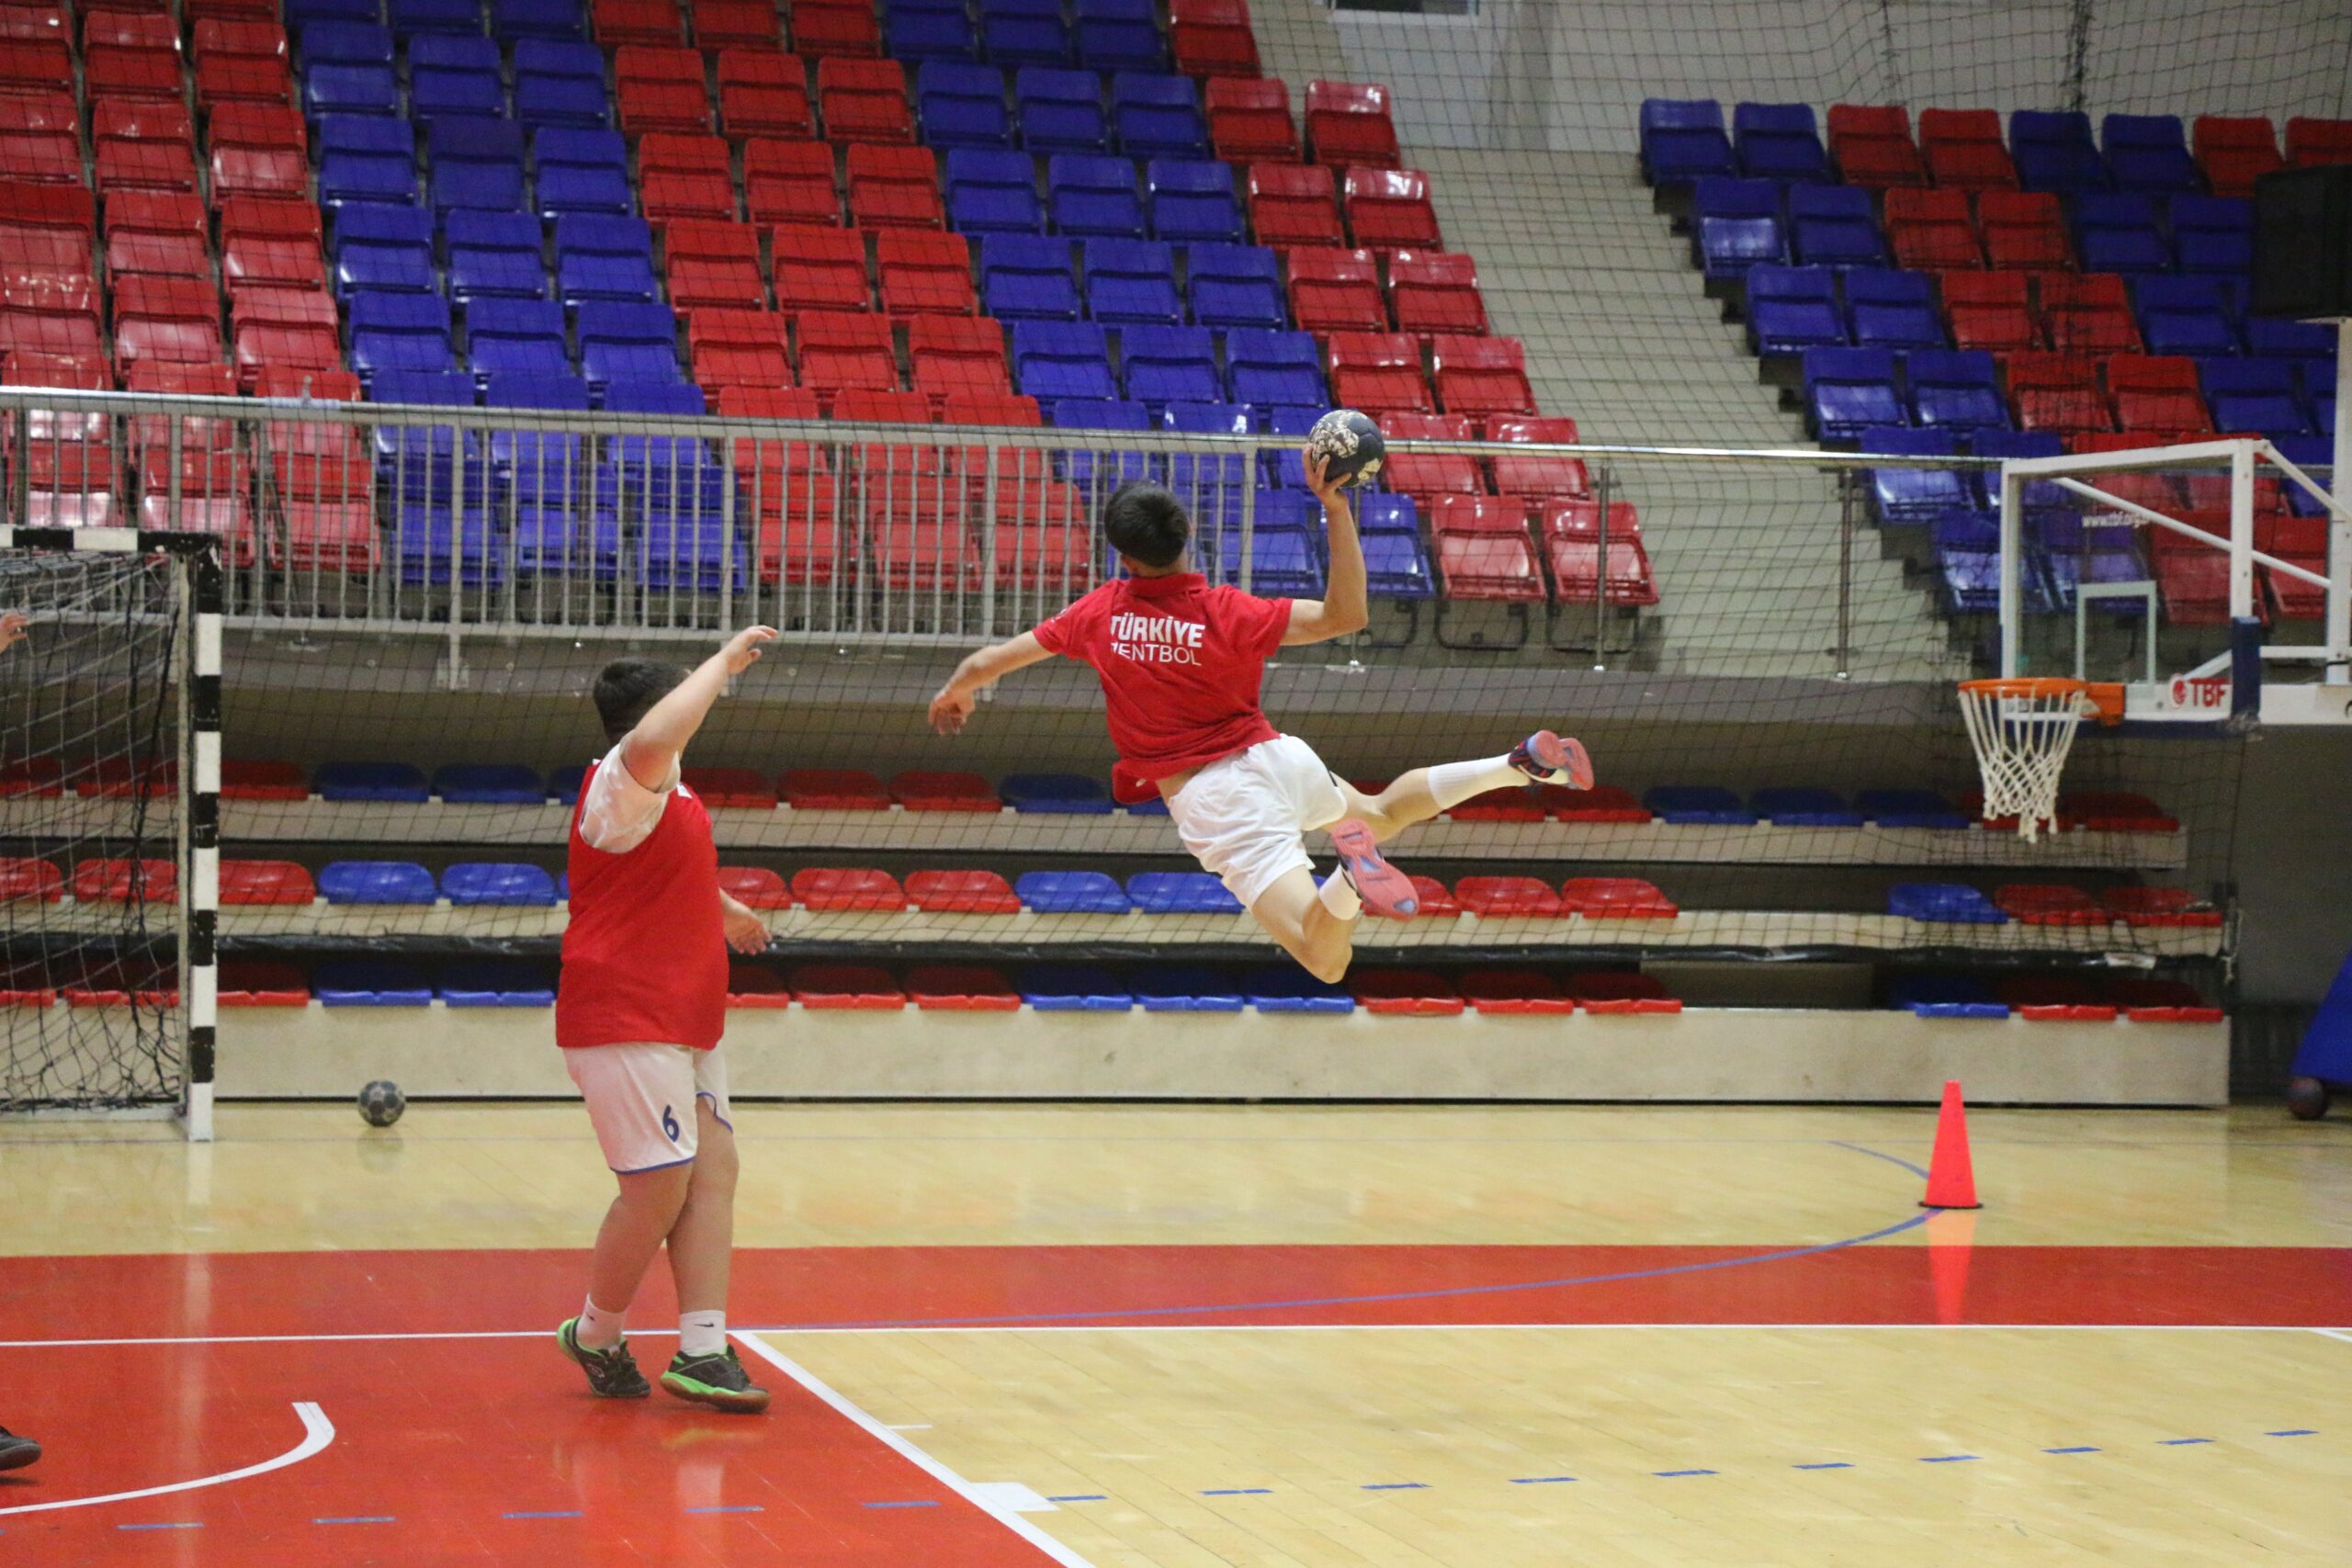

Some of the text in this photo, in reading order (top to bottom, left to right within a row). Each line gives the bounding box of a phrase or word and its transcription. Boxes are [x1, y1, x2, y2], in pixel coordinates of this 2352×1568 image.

[1110, 612, 1205, 648] TÜRKİYE
[2189, 677, 2229, 707] TBF
[662, 1104, 680, 1143] 6
